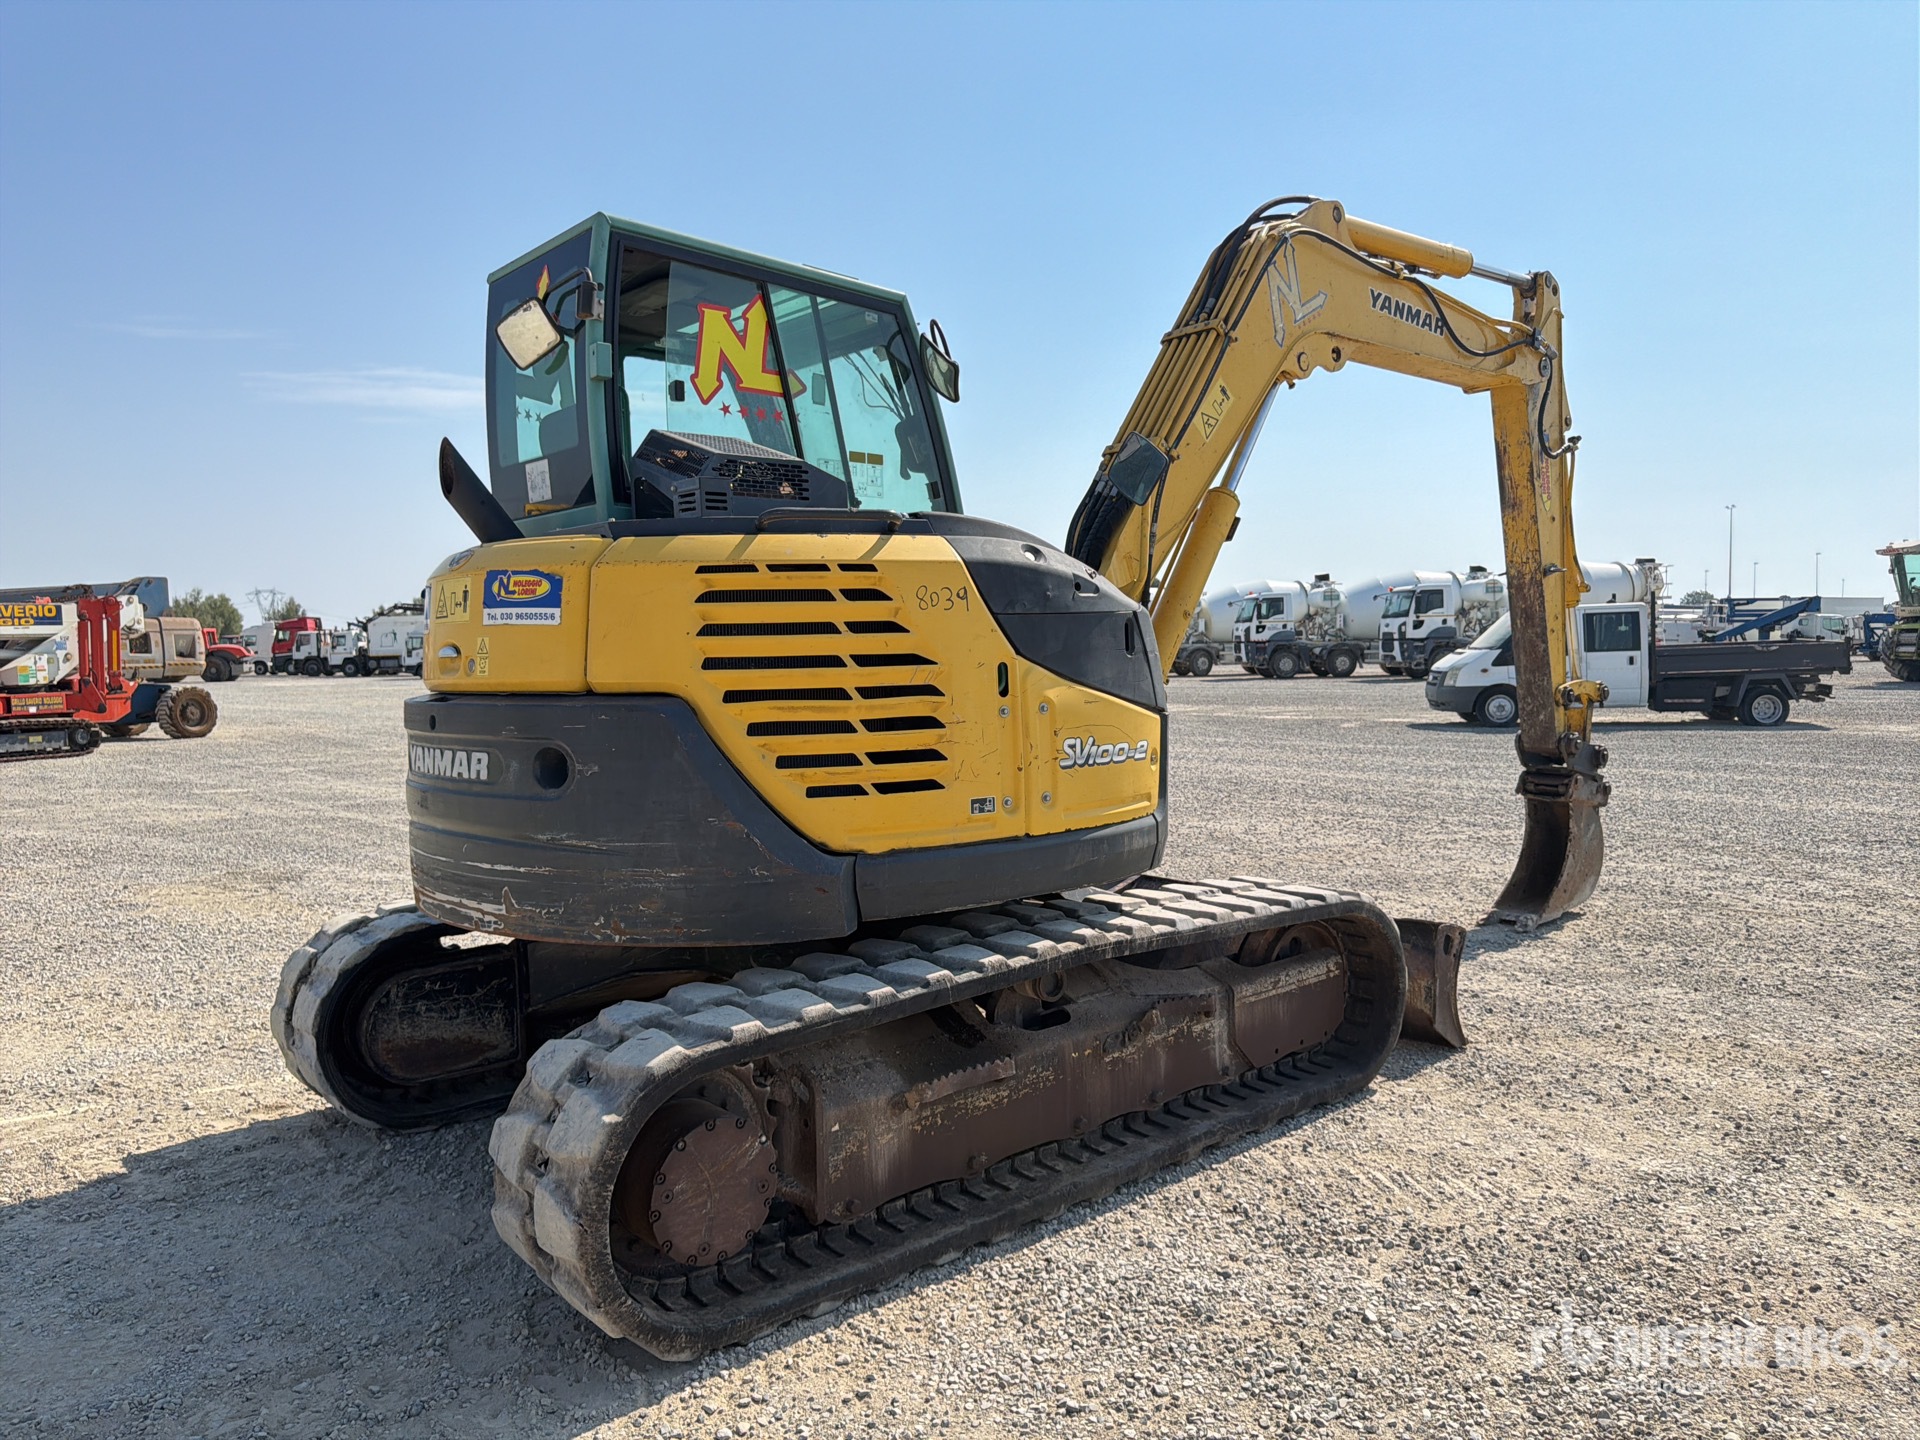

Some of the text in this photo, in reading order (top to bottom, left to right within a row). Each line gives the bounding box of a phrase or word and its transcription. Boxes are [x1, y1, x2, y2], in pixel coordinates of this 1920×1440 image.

[1369, 288, 1445, 337] YANMAR
[517, 588, 538, 596] LORINI
[915, 585, 970, 612] 8039
[487, 612, 556, 621] Tel. 030 9650555/6
[409, 743, 489, 780] YANMAR
[1060, 735, 1148, 769] SV100-2
